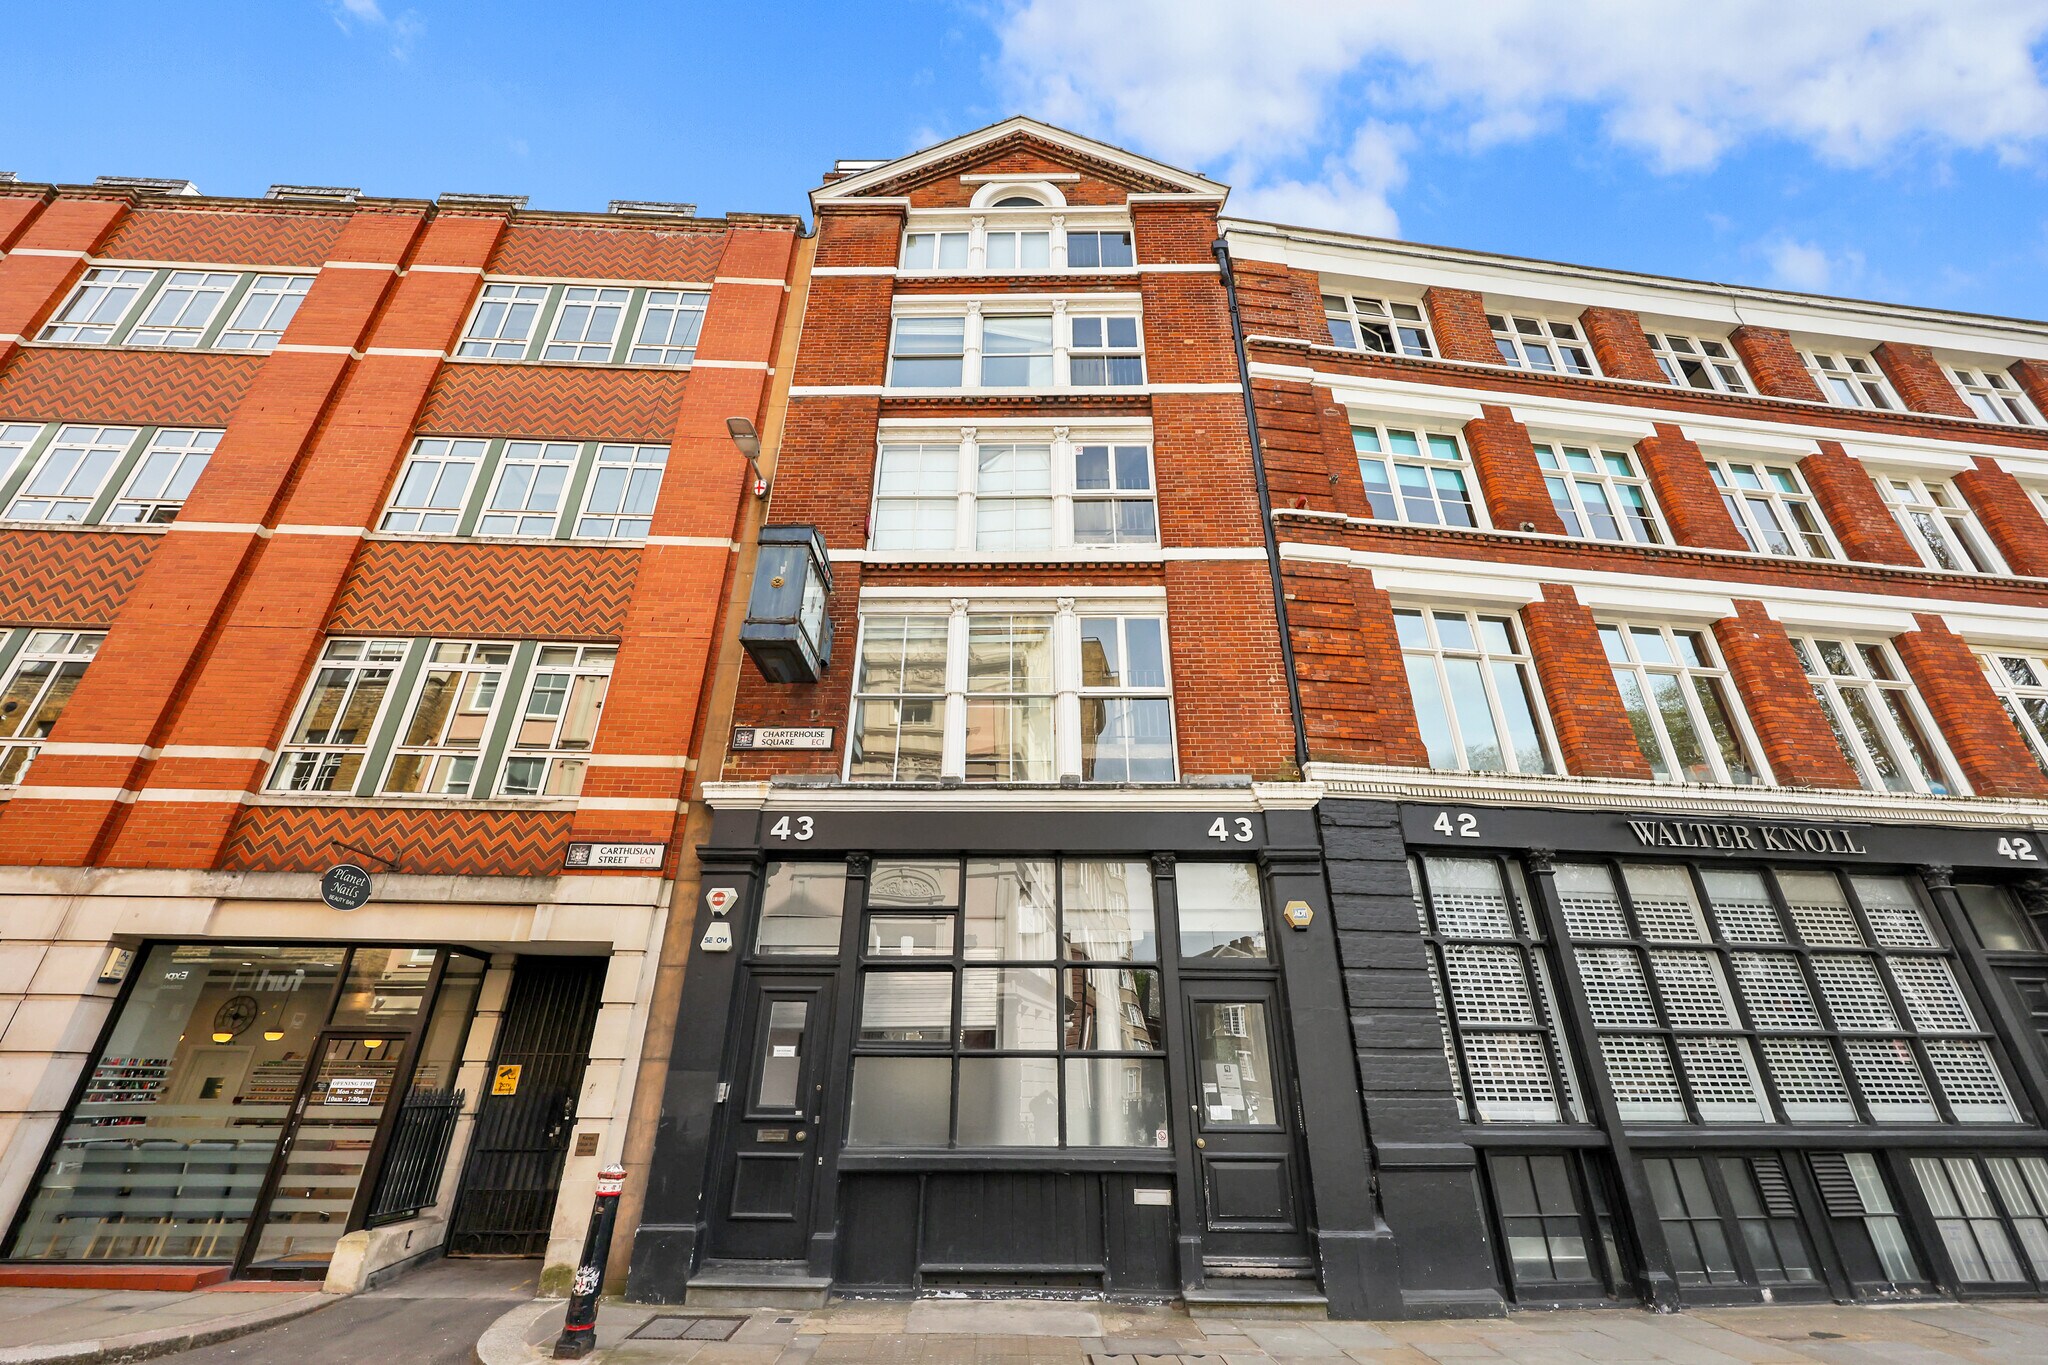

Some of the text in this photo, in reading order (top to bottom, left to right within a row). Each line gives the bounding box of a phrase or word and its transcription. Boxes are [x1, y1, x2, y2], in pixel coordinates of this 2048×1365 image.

[761, 738, 794, 746] SQUARE
[762, 730, 825, 738] CHARTERHOUSE
[770, 815, 814, 841] 43
[1208, 817, 1254, 842] 43
[1433, 811, 1480, 838] 42
[1627, 820, 1867, 854] WALTER KNOLL
[599, 846, 656, 855] CARTHUSIAN
[1996, 837, 2039, 860] 42
[598, 855, 654, 864] STREET EC1
[333, 868, 366, 887] Planet
[330, 881, 360, 898] Nails
[328, 894, 346, 904] BEAUTY
[704, 936, 728, 944] SEOM
